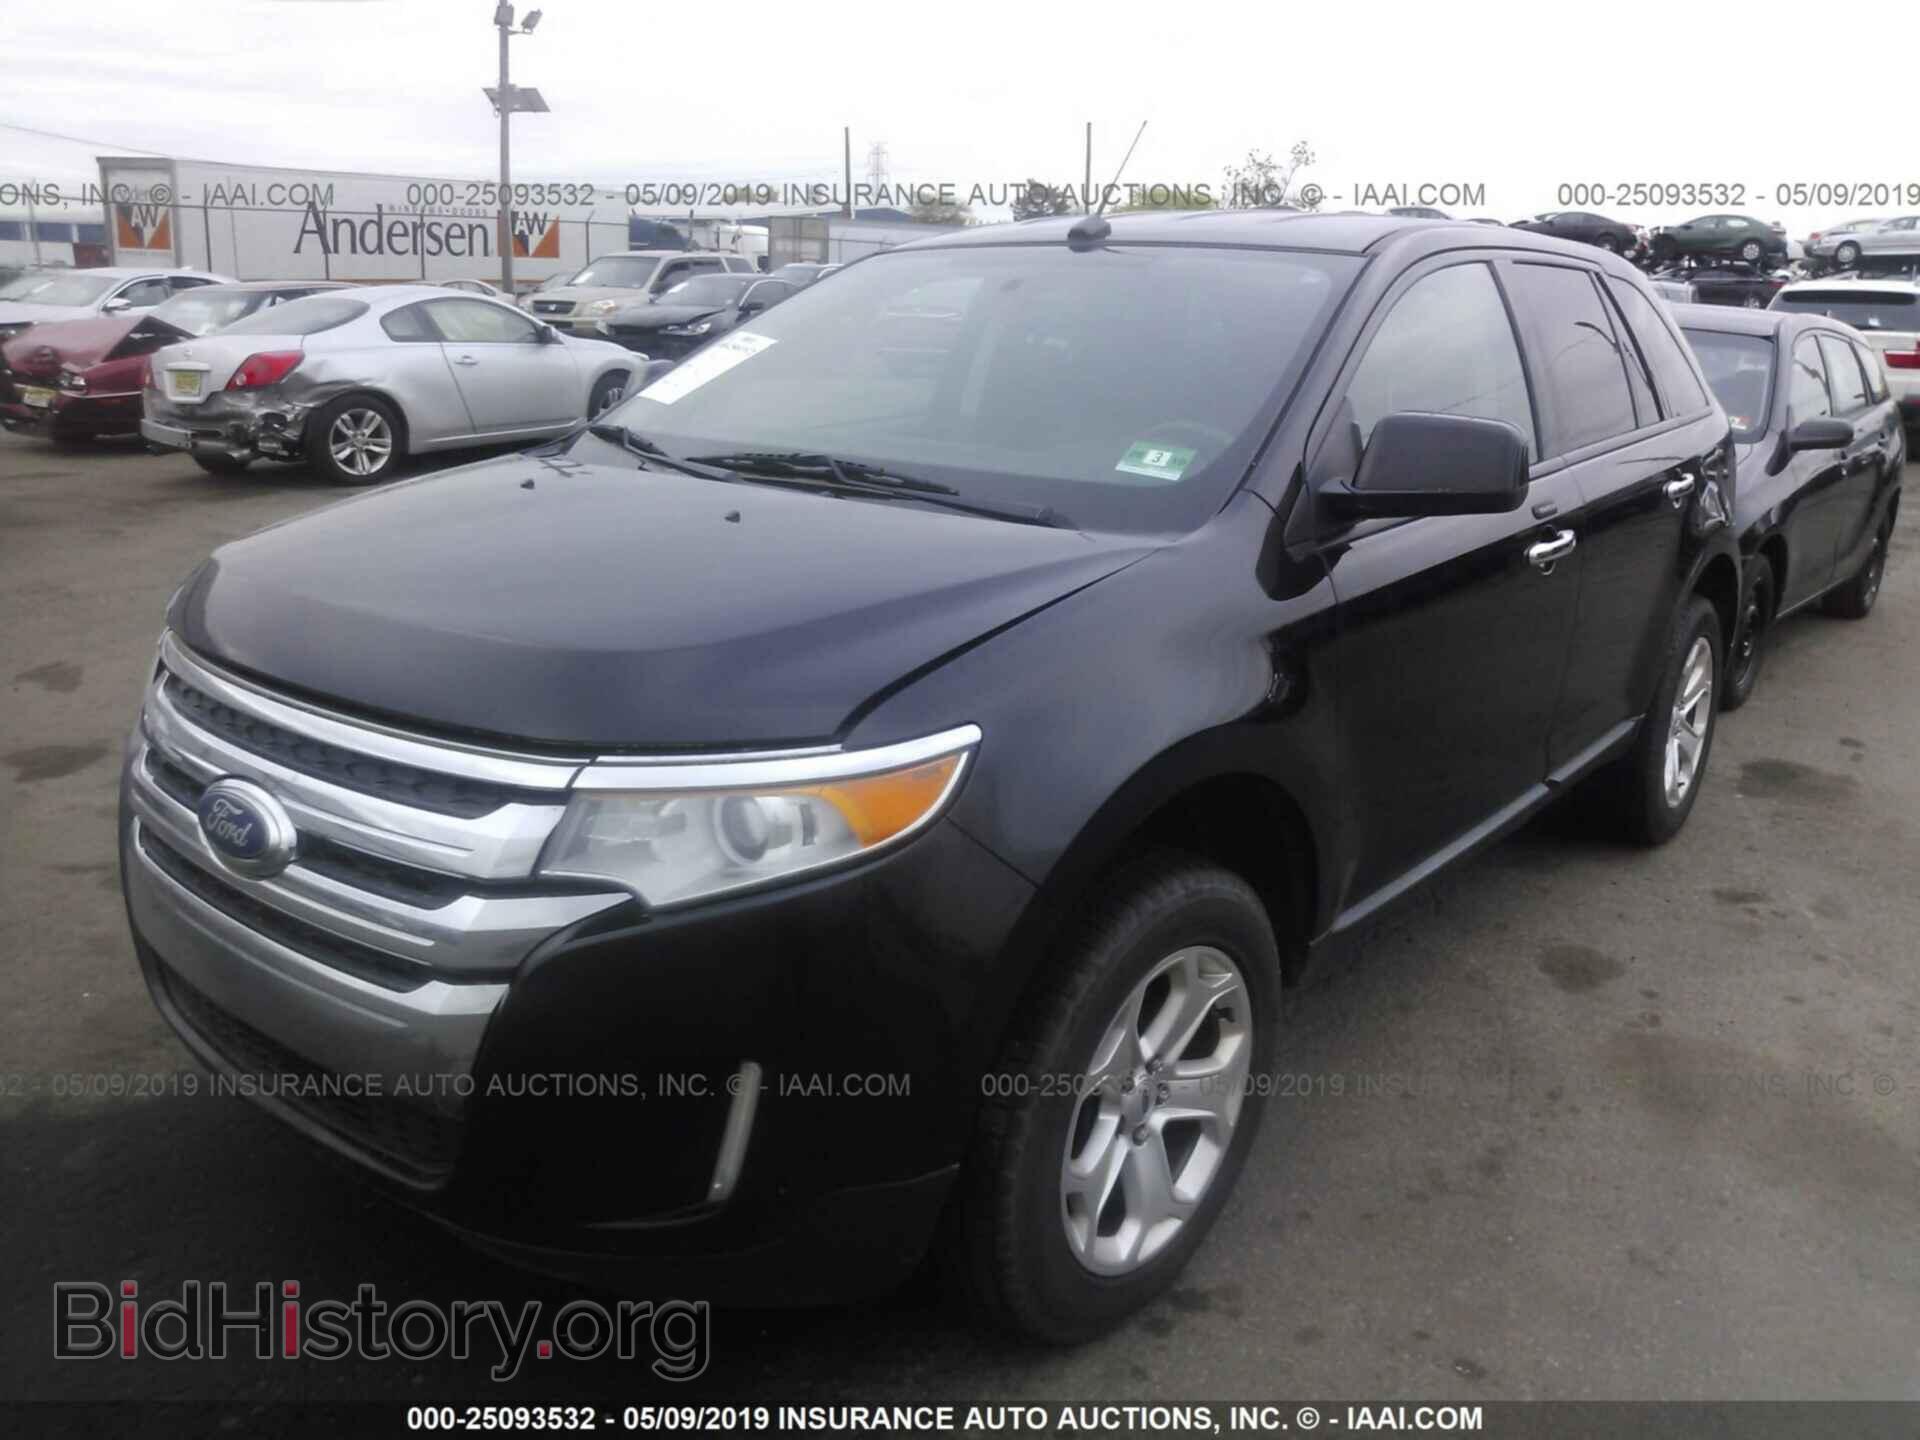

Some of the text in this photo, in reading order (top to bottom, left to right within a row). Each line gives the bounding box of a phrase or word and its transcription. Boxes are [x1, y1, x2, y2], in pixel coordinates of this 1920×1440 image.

[294, 202, 489, 256] Andersen
[1151, 451, 1164, 463] 3
[206, 797, 253, 848] Ford
